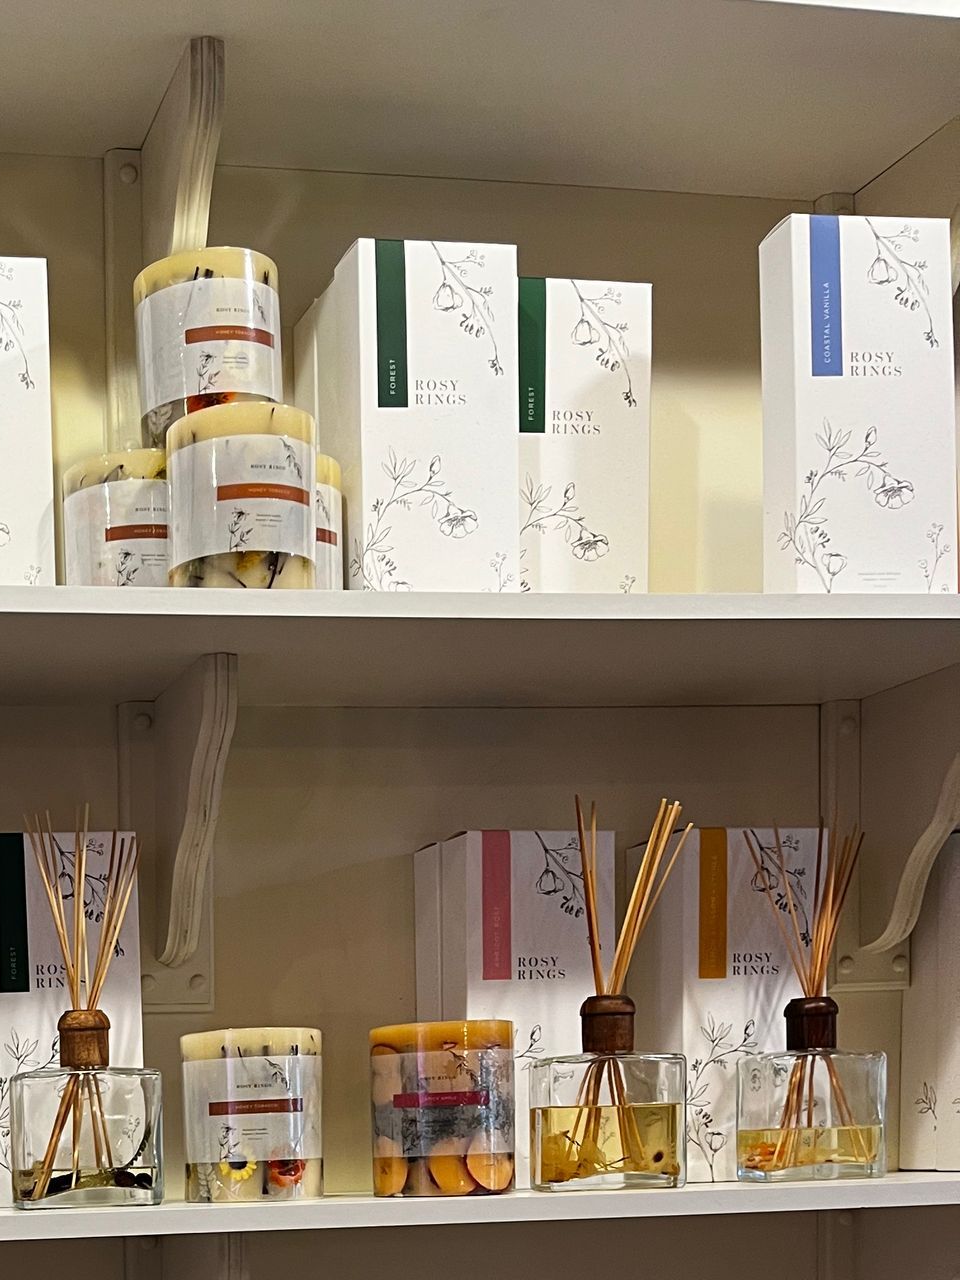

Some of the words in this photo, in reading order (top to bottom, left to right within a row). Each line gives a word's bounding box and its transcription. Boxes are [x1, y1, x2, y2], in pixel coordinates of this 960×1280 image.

[823, 281, 831, 320] VANILLA
[823, 323, 832, 364] COASTAL
[850, 351, 895, 363] ROSY
[850, 365, 903, 377] RINGS
[415, 379, 459, 391] ROSY
[415, 393, 468, 405] RINGS
[527, 387, 535, 421] FOREST
[552, 410, 594, 421] ROSY
[552, 424, 601, 435] RINGS
[10, 946, 18, 980] FOREST
[518, 956, 559, 968] ROSY
[732, 952, 773, 963] ROSY
[518, 969, 566, 981] RINGS
[732, 965, 780, 976] RINGS
